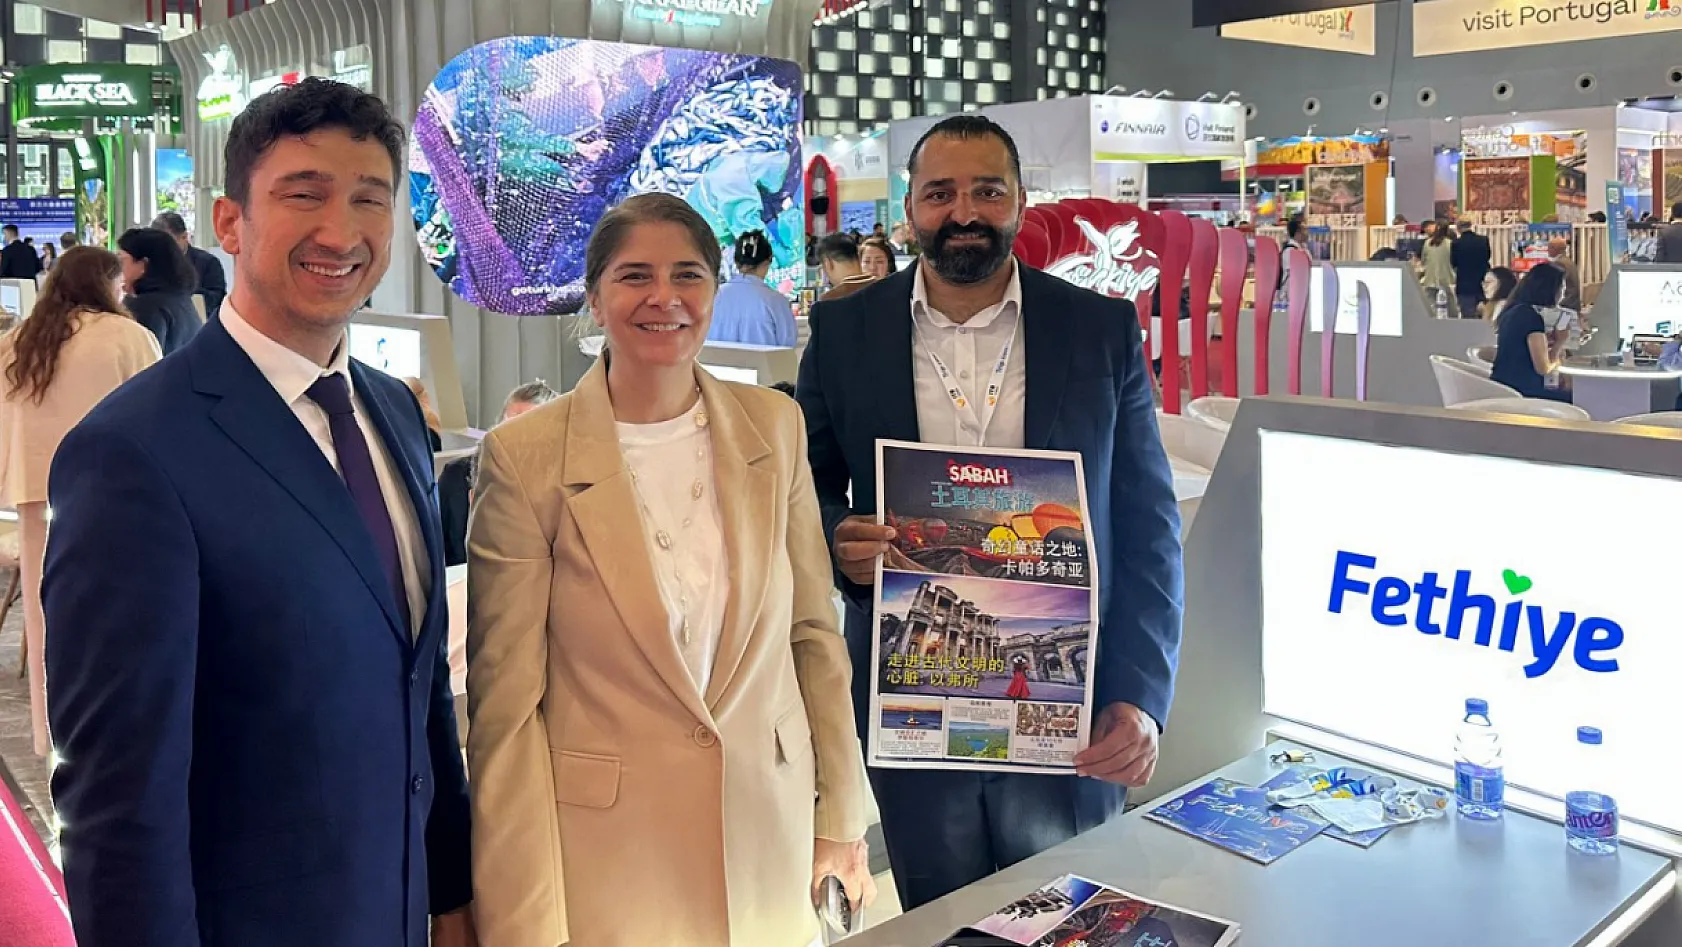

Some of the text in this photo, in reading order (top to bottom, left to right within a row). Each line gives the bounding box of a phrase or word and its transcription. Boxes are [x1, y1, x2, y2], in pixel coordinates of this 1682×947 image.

[1463, 0, 1637, 31] visit Portugal
[1114, 122, 1166, 135] FINNAIR
[949, 465, 1009, 484] SABAH
[1002, 558, 1084, 578] 卡帕多奇亚
[1327, 550, 1625, 679] Fethiye
[887, 652, 1005, 673] 走进古代文明的
